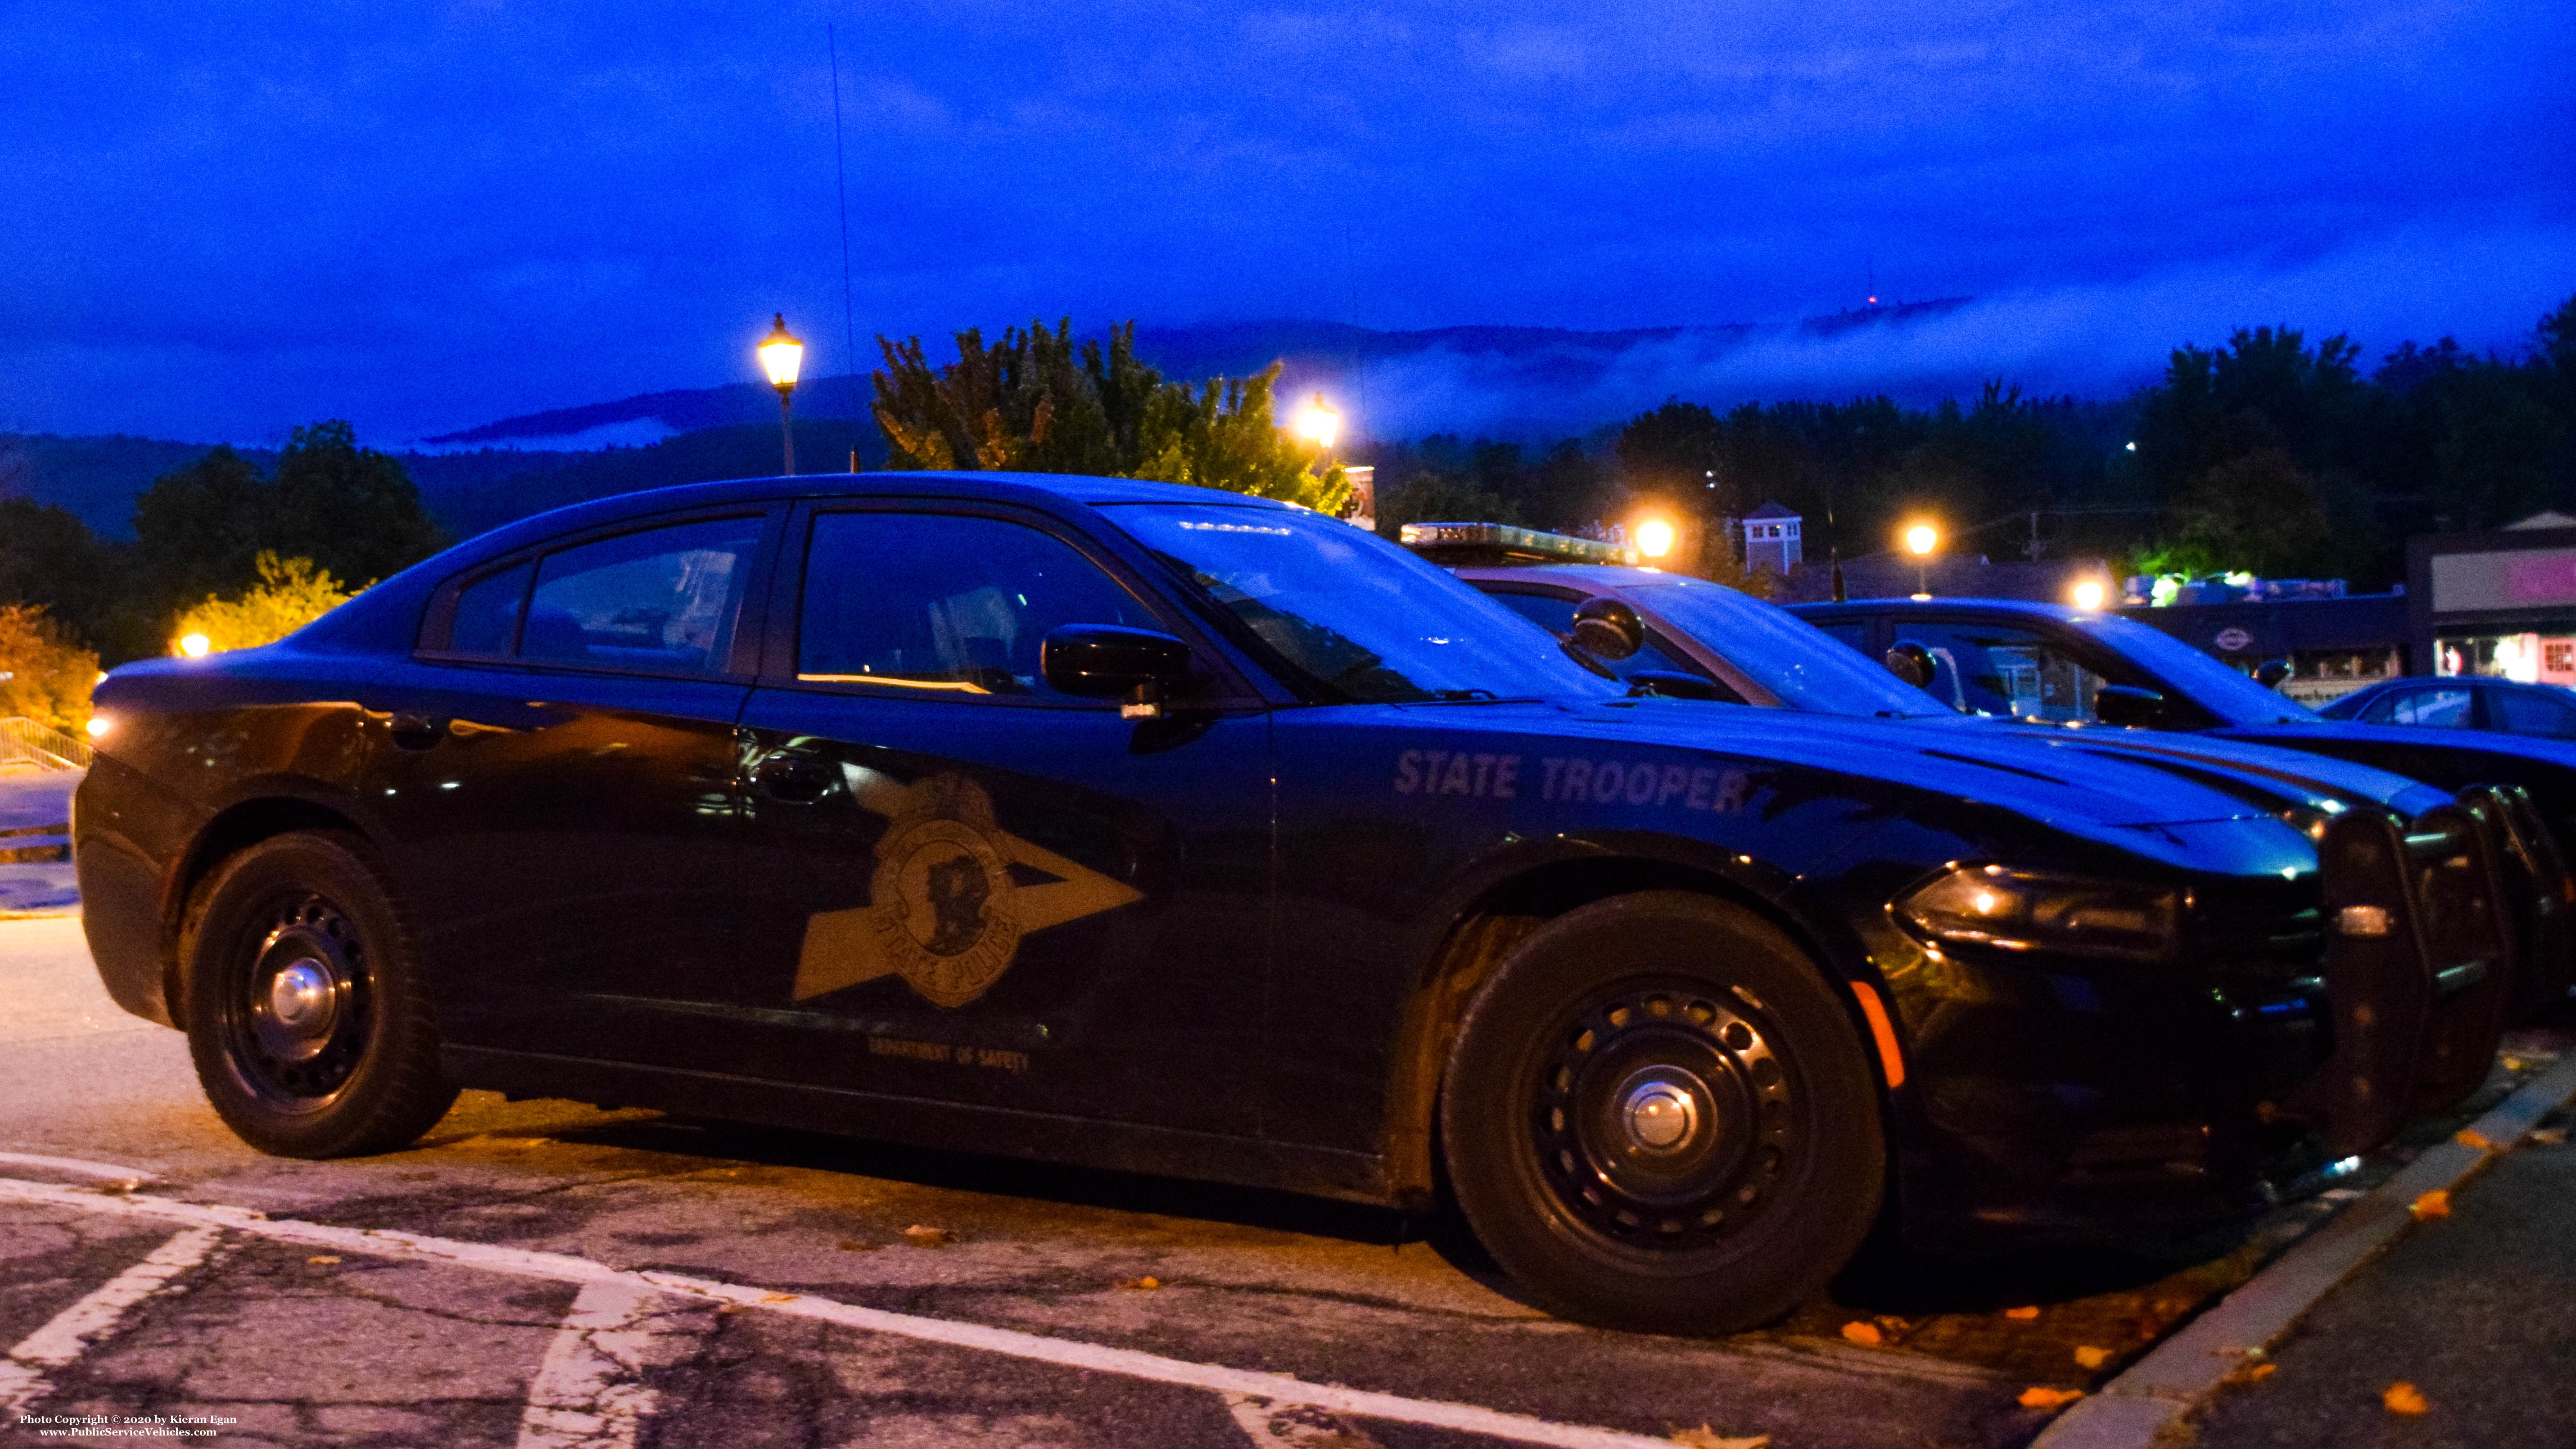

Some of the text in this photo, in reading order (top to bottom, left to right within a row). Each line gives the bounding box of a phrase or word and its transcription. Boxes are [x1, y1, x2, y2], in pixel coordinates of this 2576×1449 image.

[1394, 749, 1749, 813] STATE TROOPER
[951, 918, 1018, 989] POLICE
[955, 1046, 974, 1065] OF
[977, 1048, 1029, 1075] SAFETY
